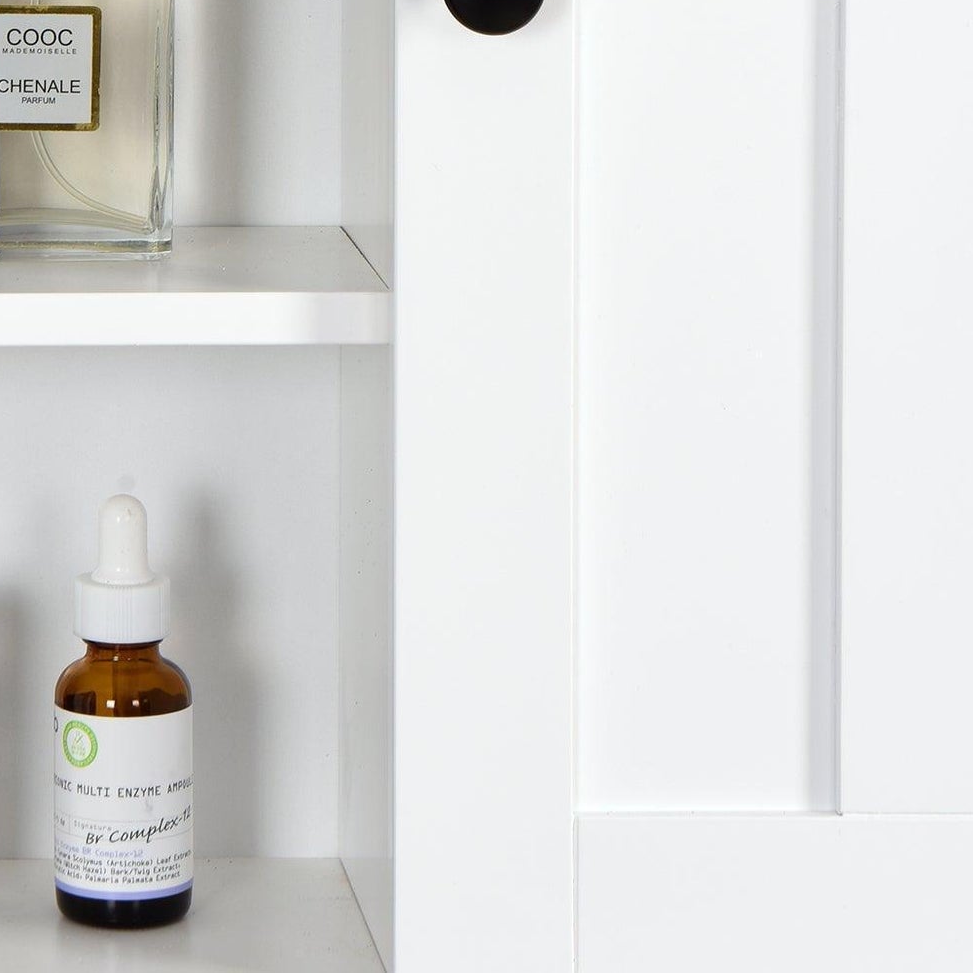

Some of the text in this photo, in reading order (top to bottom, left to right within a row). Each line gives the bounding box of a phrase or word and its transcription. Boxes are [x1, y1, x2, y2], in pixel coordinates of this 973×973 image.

[6, 28, 73, 46] COOC
[21, 96, 56, 104] PARFUM
[76, 783, 110, 798] MULTI
[118, 784, 161, 798] ENZYME
[85, 832, 103, 845] Br
